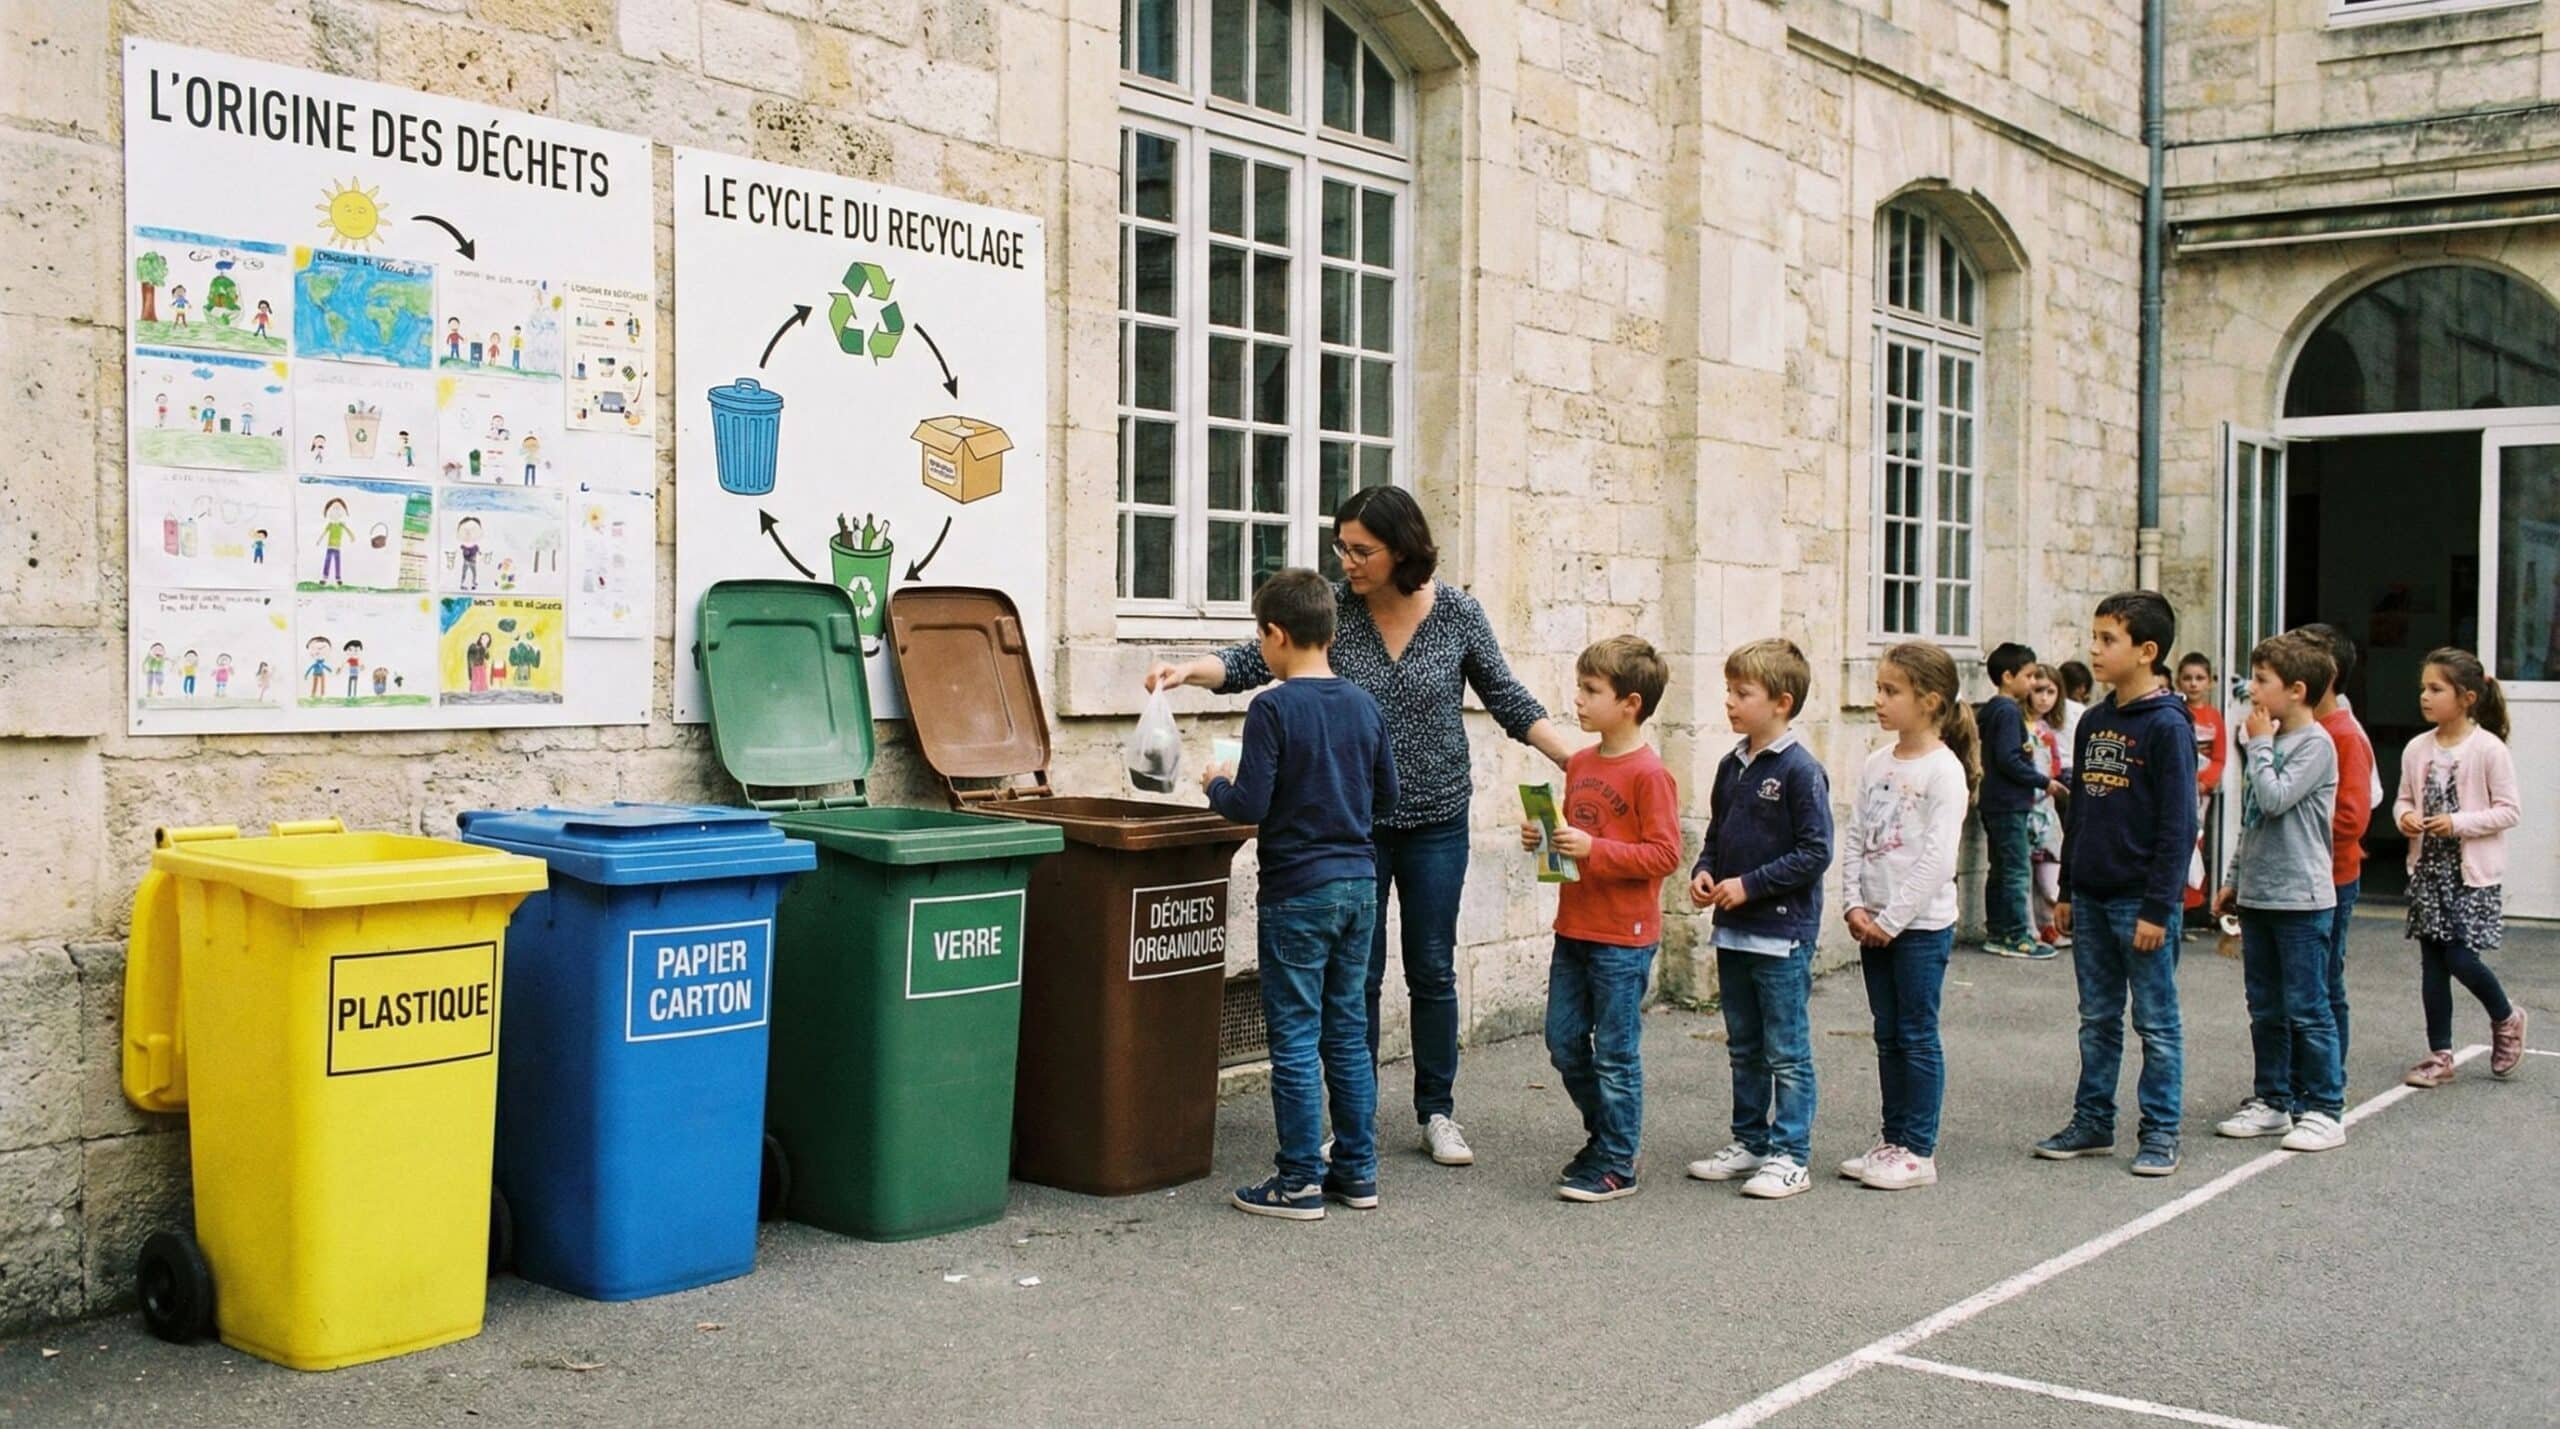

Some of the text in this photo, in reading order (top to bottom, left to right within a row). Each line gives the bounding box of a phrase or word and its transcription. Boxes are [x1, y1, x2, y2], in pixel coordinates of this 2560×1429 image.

[150, 68, 609, 198] L'ORIGINE DES DÉCHETS
[704, 174, 1024, 270] LE CYCLE DU RECYCLAGE
[1150, 895, 1215, 930] DÉCHETS
[657, 939, 747, 980] PAPIER
[933, 925, 1002, 961] VERRE
[1134, 925, 1225, 965] ORGANIQUES
[338, 982, 489, 1032] PLASTIQUE
[649, 978, 752, 1021] CARTON
